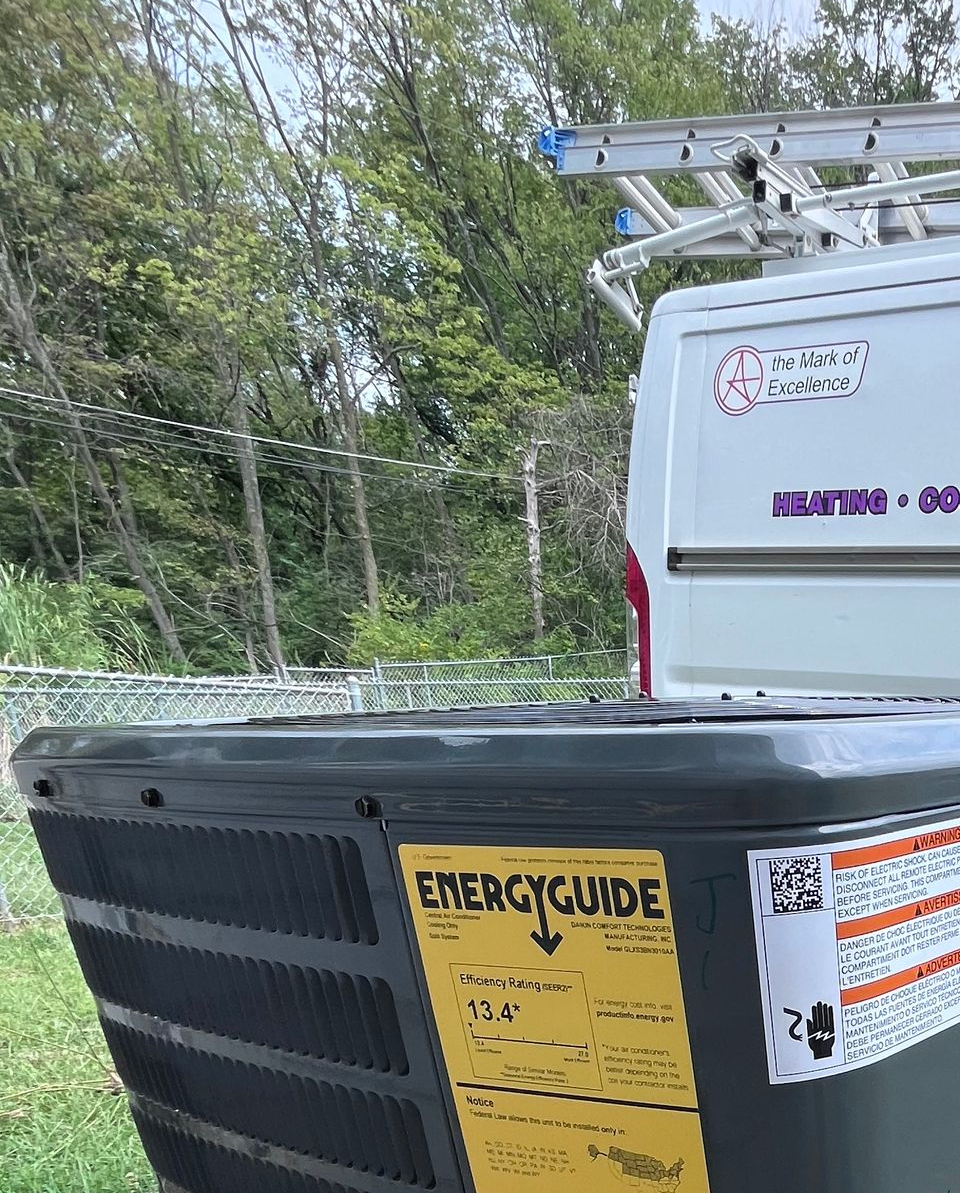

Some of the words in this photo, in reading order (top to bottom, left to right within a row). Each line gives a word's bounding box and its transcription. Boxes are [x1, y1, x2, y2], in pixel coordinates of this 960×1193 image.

[772, 355, 795, 372] the
[800, 350, 838, 369] Mark
[842, 346, 860, 365] of
[768, 377, 850, 397] Excellence
[772, 488, 887, 517] HEATING
[920, 828, 960, 848] WARNING
[836, 871, 856, 882] RISK
[858, 869, 869, 878] OF
[871, 861, 902, 876] ELECTRIC
[928, 851, 940, 861] CAN
[942, 846, 960, 859] CAUSE
[836, 876, 886, 894] DISCONNECT
[888, 872, 901, 883] ALL
[901, 864, 927, 880] REMOTE
[928, 858, 956, 872] ELECTRIC
[415, 871, 665, 919] ENERGYGUIDE
[837, 891, 871, 906] BEFORE
[911, 877, 924, 888] THIS
[837, 904, 871, 918] EXCEPT
[872, 898, 893, 910] WHEN
[571, 921, 591, 929] DAIKIN
[592, 922, 621, 930] COMFORT
[623, 924, 671, 932] TECHNOLOGIES
[840, 937, 874, 952] DANGER
[876, 933, 885, 942] DE
[854, 943, 889, 960] COURANT
[460, 974, 506, 990] Efficiency
[509, 977, 541, 992] Rating
[596, 1011, 674, 1023] productinfo.energy.gov
[845, 1000, 879, 1017] PELIGRO
[845, 1013, 873, 1028] TODAS
[874, 1007, 887, 1019] LAS
[847, 1041, 883, 1060] SERVICIO
[466, 1096, 494, 1108] Notice
[469, 1109, 492, 1119] Federal
[494, 1112, 507, 1120] Law
[573, 1123, 600, 1132] installed
[601, 1127, 616, 1135] only
